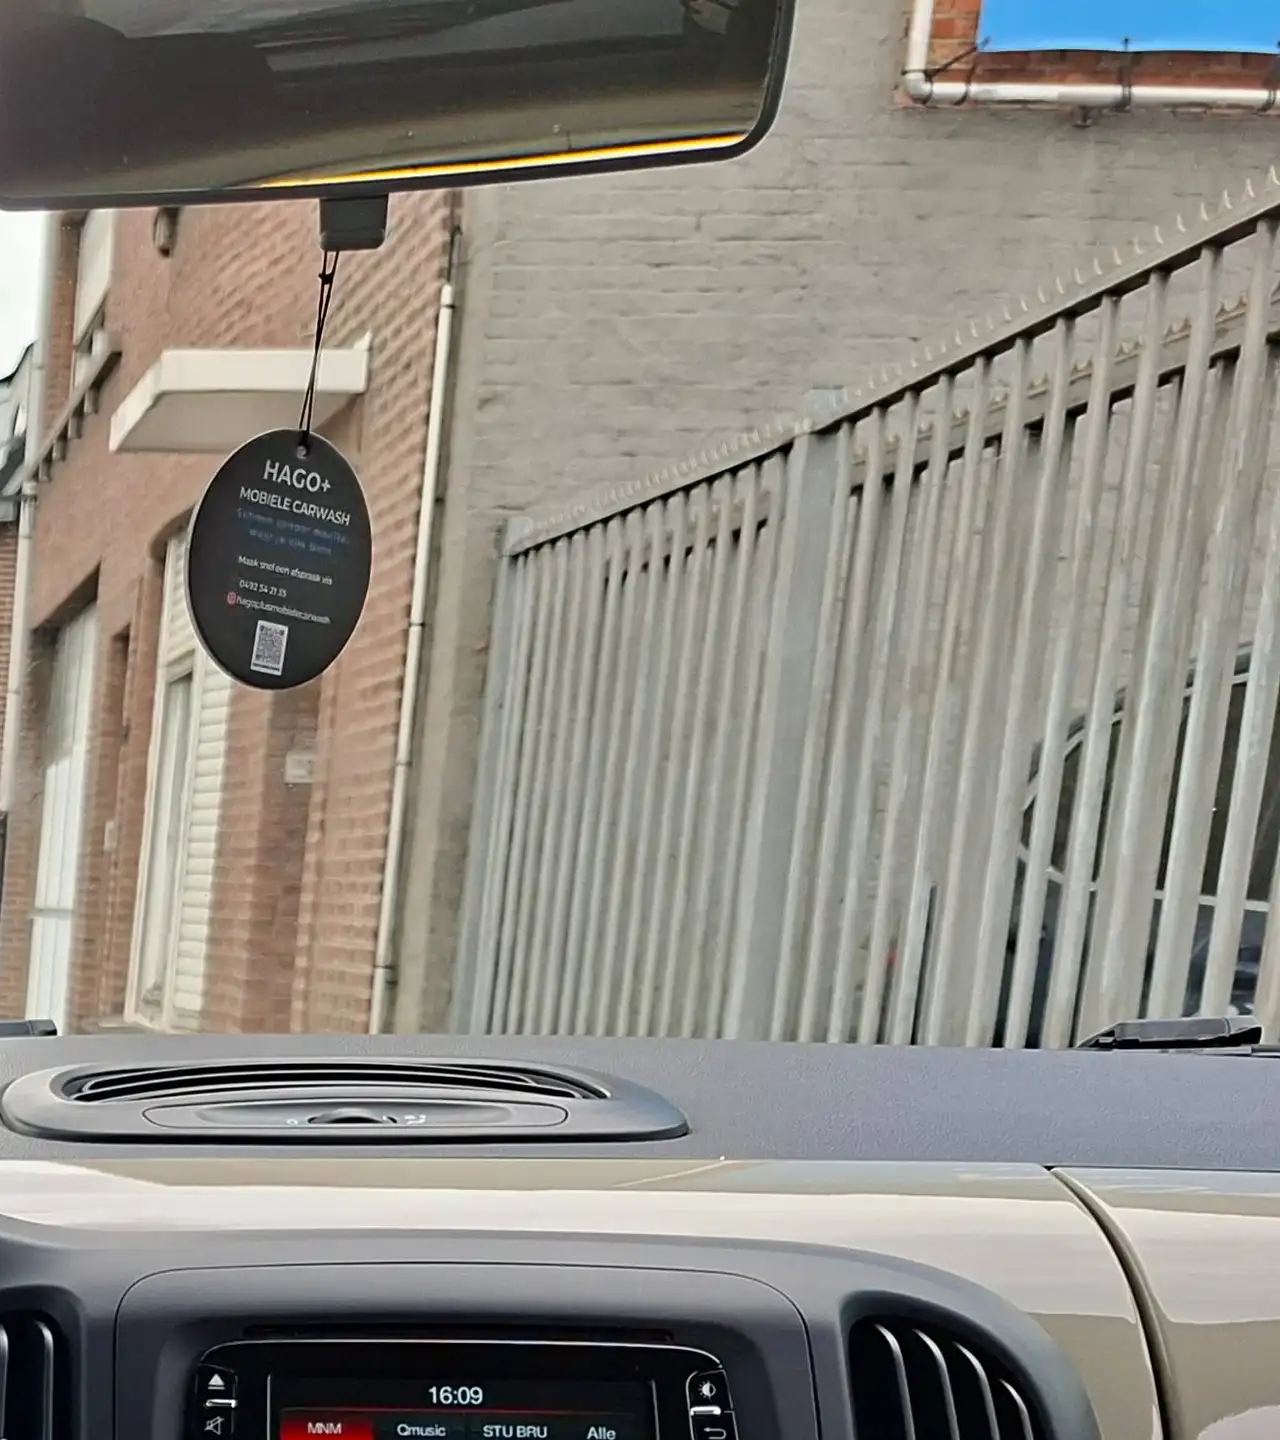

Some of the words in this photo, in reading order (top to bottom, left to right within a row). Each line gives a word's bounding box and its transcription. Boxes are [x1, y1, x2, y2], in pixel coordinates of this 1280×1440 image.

[264, 459, 332, 493] HAGO+
[239, 486, 292, 512] MOBIELE
[292, 499, 351, 527] CARWASH
[428, 1386, 483, 1405] 16:09
[307, 1421, 342, 1435] MNM
[397, 1424, 446, 1437] Qmusic
[483, 1425, 513, 1438] STU
[516, 1426, 548, 1439] BRU
[587, 1427, 616, 1440] Alle
